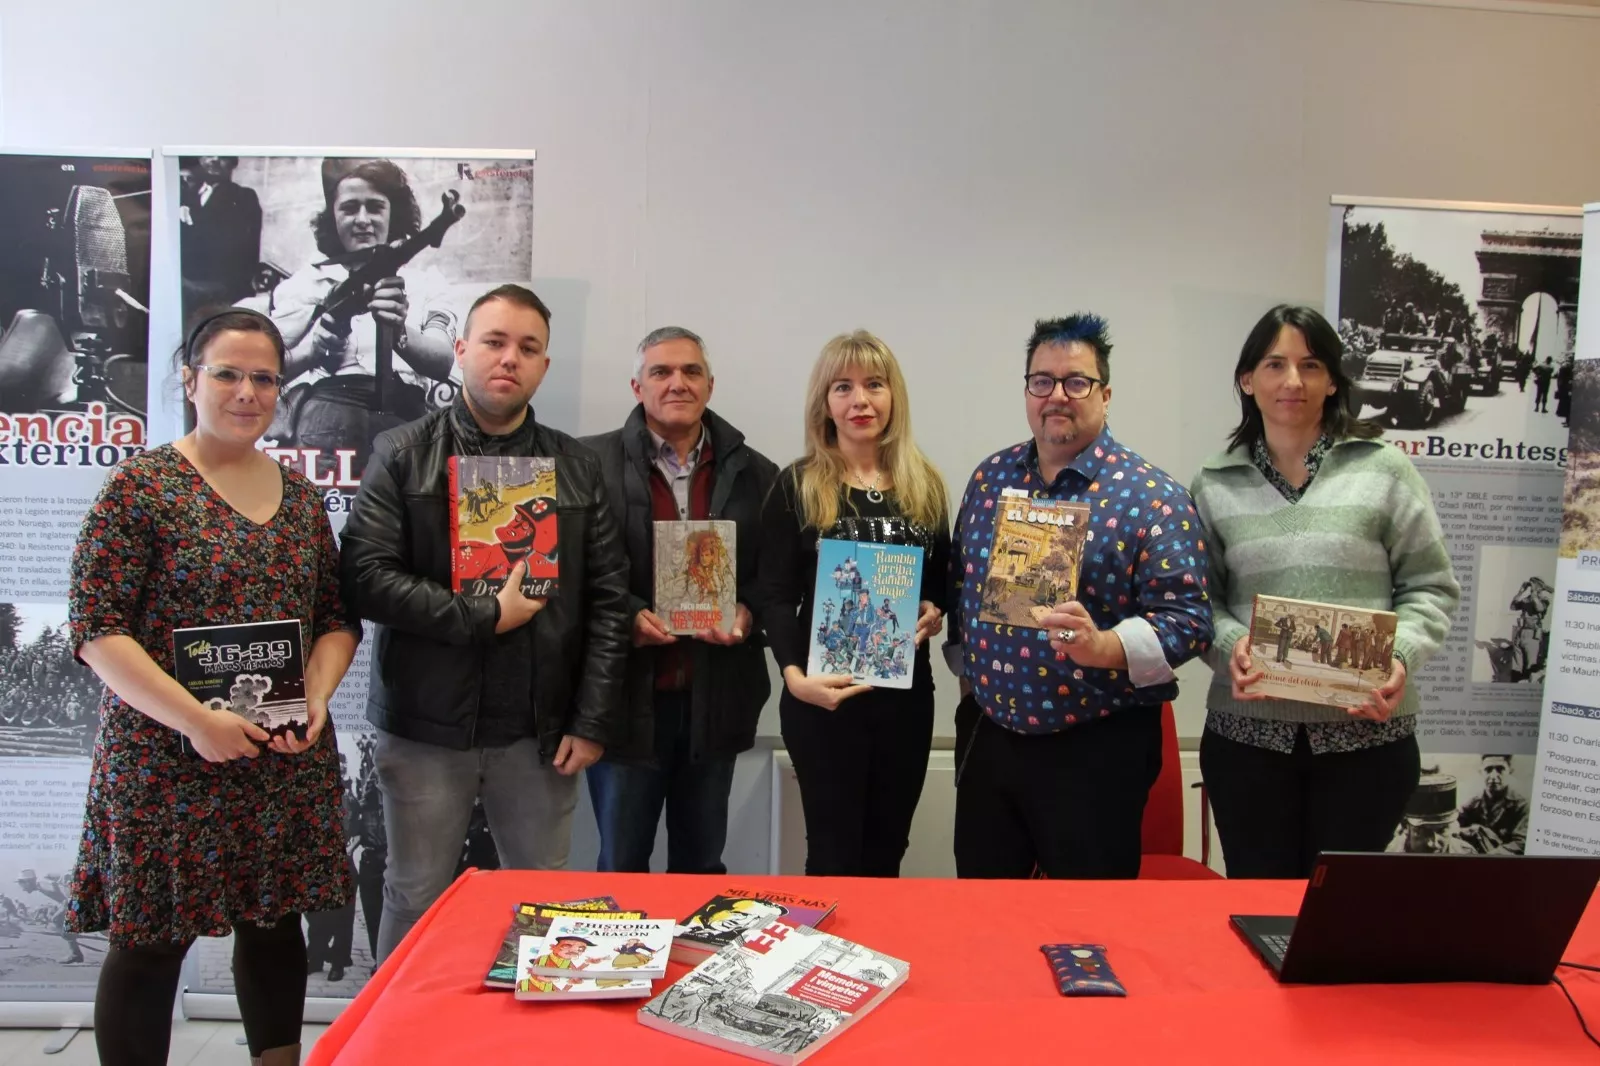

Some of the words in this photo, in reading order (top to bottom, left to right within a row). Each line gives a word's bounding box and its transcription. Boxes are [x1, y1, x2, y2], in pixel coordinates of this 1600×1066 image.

[25, 496, 48, 504] frente
[25, 508, 50, 518] Legión
[1007, 509, 1023, 522] EL
[1027, 510, 1075, 528] SOLAR
[1472, 513, 1487, 521] libre
[1517, 517, 1540, 525] mayor
[1469, 523, 1504, 532] franceses
[1466, 533, 1493, 541] función
[1517, 536, 1543, 544] unidad
[28, 544, 70, 553] Resistencia
[36, 556, 66, 566] quienes
[874, 551, 916, 565] Rambla
[1581, 556, 1600, 566] PR
[472, 580, 498, 597] Dr.
[199, 640, 292, 667] 36-39
[205, 660, 241, 675] MALOS
[1424, 664, 1450, 672] Comité
[1560, 665, 1570, 673] de
[1425, 707, 1457, 716] confirma
[1468, 709, 1503, 719] presencia
[1540, 803, 1572, 818] forzoso
[1575, 811, 1587, 820] en
[1552, 830, 1561, 838] de
[1551, 840, 1560, 848] de
[725, 888, 750, 898] MIL
[753, 892, 794, 904] VIDAS
[797, 898, 828, 909] MÁS
[521, 905, 536, 916] EL
[585, 922, 661, 930] HISTORIA
[816, 969, 869, 993] Memòria
[815, 978, 862, 999] vinyetes
